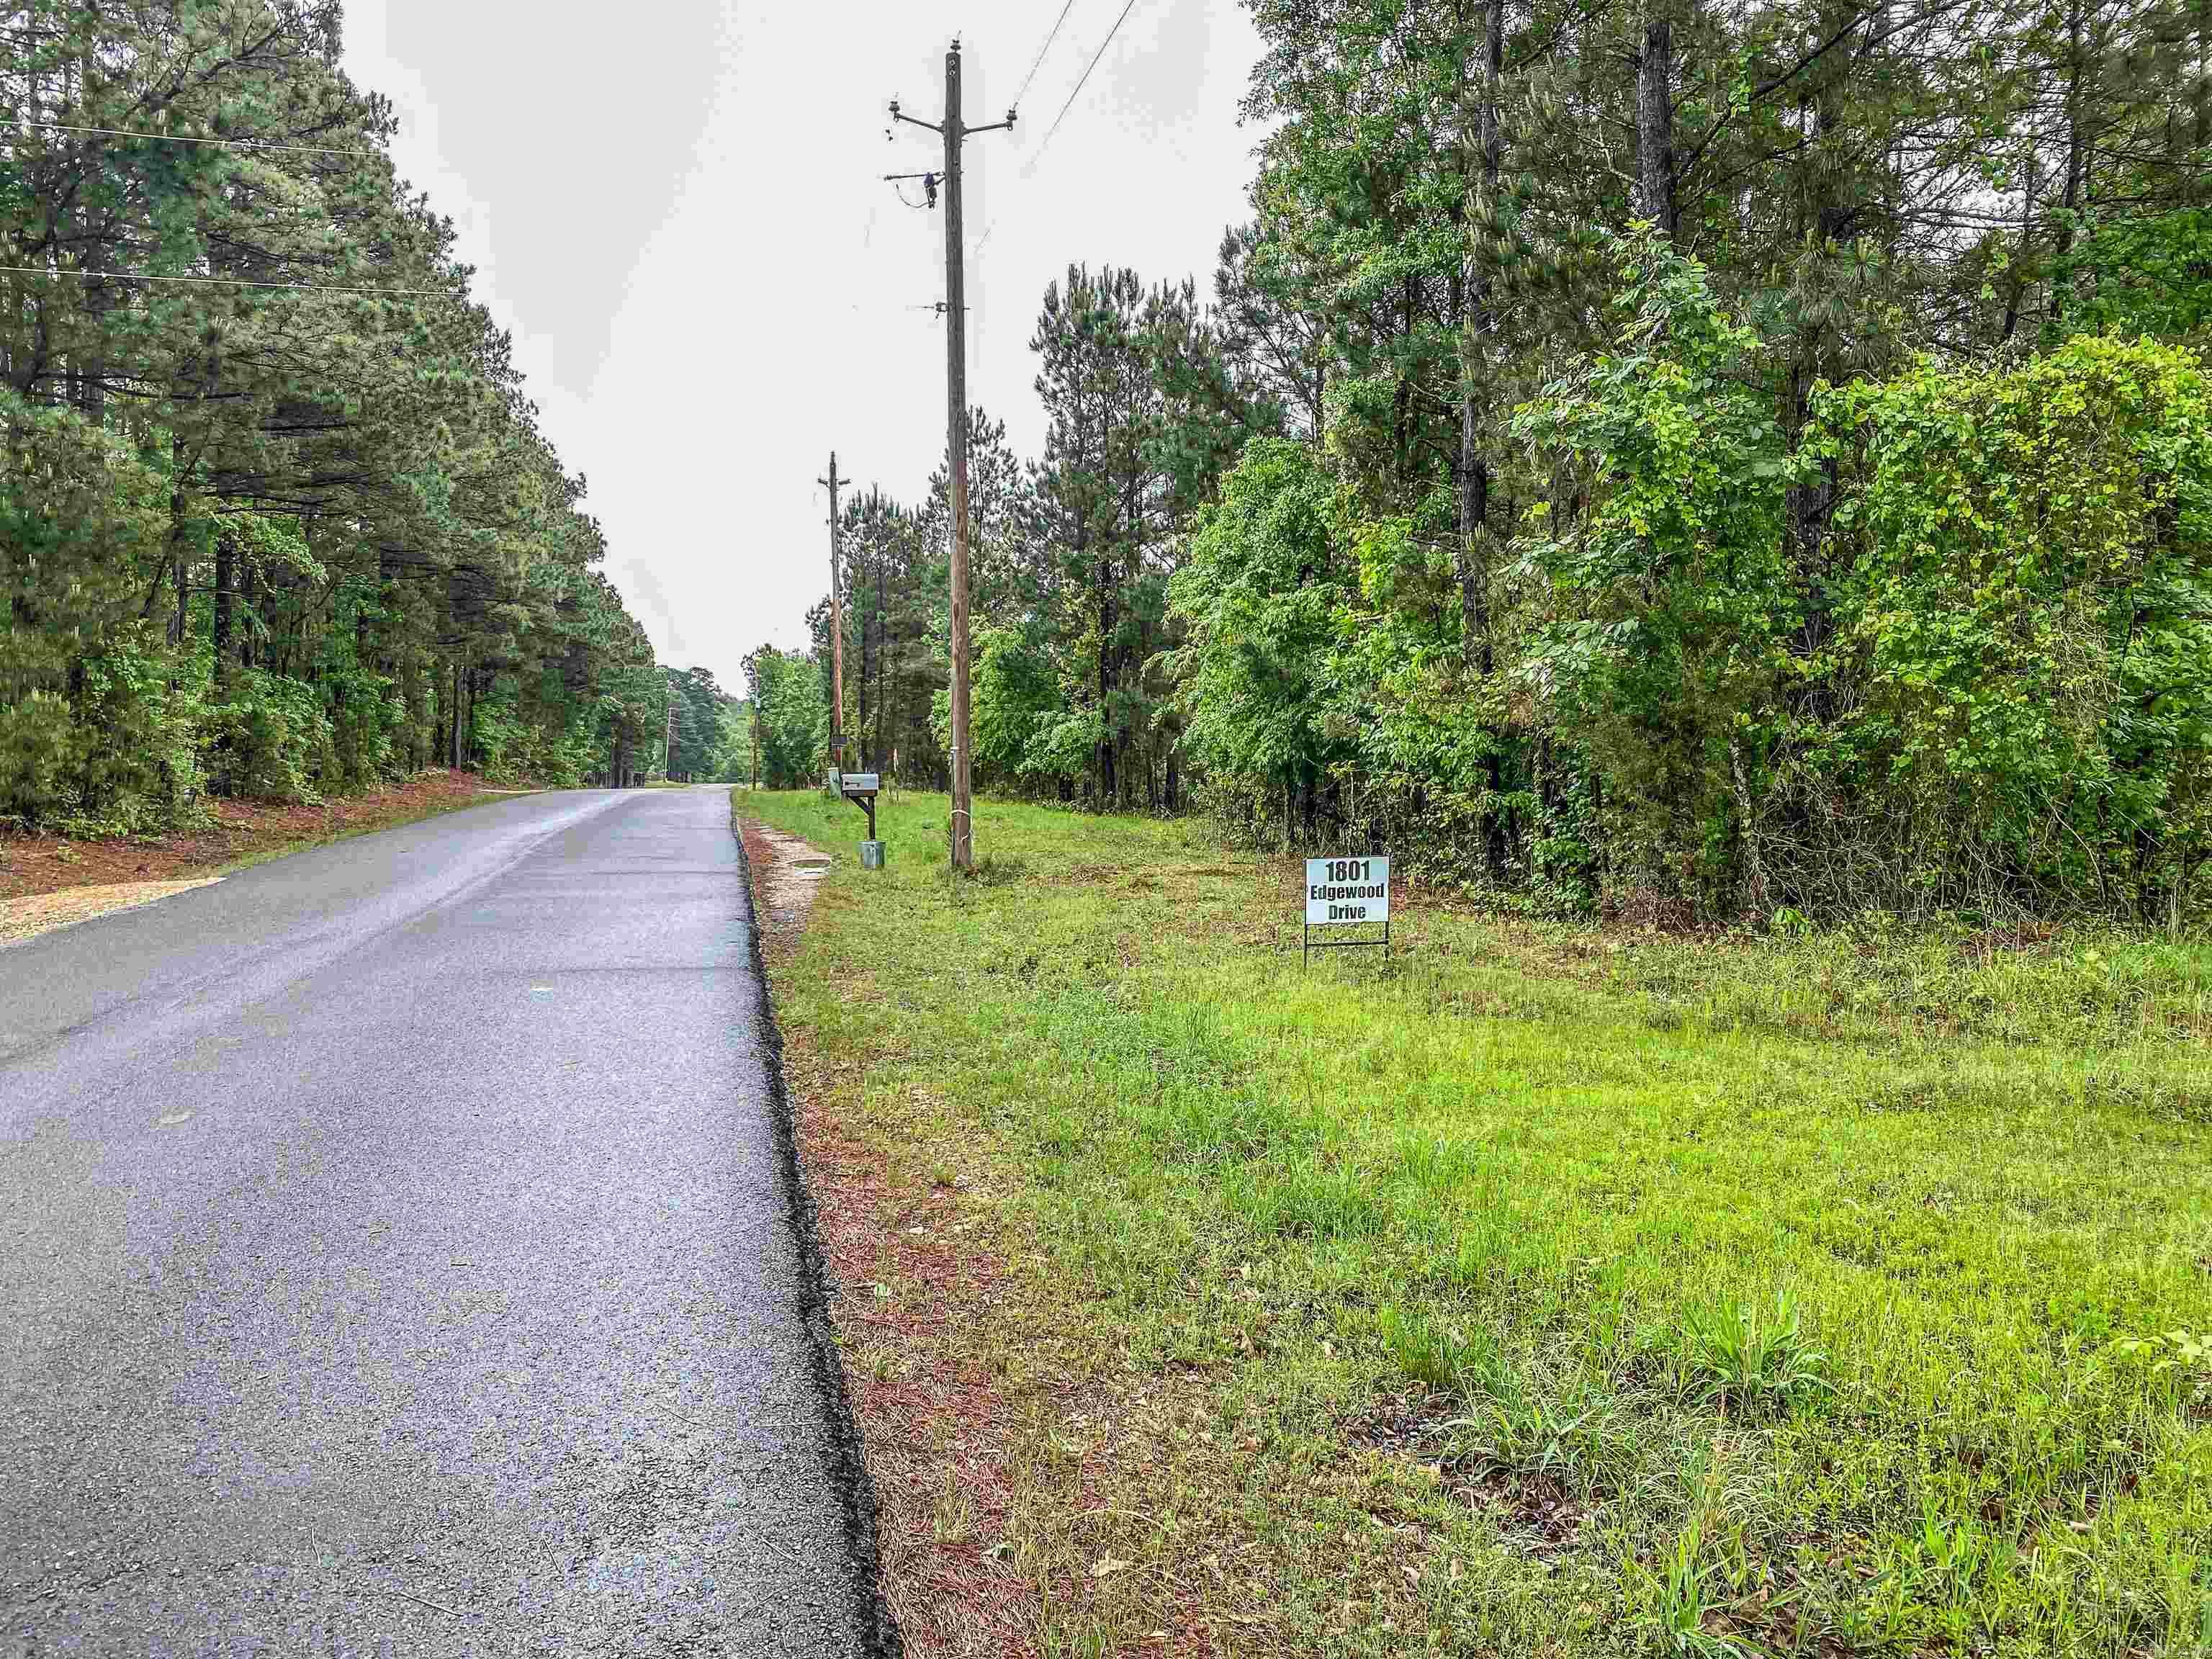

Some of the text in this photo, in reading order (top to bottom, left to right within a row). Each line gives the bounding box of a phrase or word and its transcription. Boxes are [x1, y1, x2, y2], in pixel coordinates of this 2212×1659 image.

[1326, 860, 1370, 881] 1801
[1310, 883, 1384, 901] Edgewood
[1328, 904, 1366, 920] Drive
